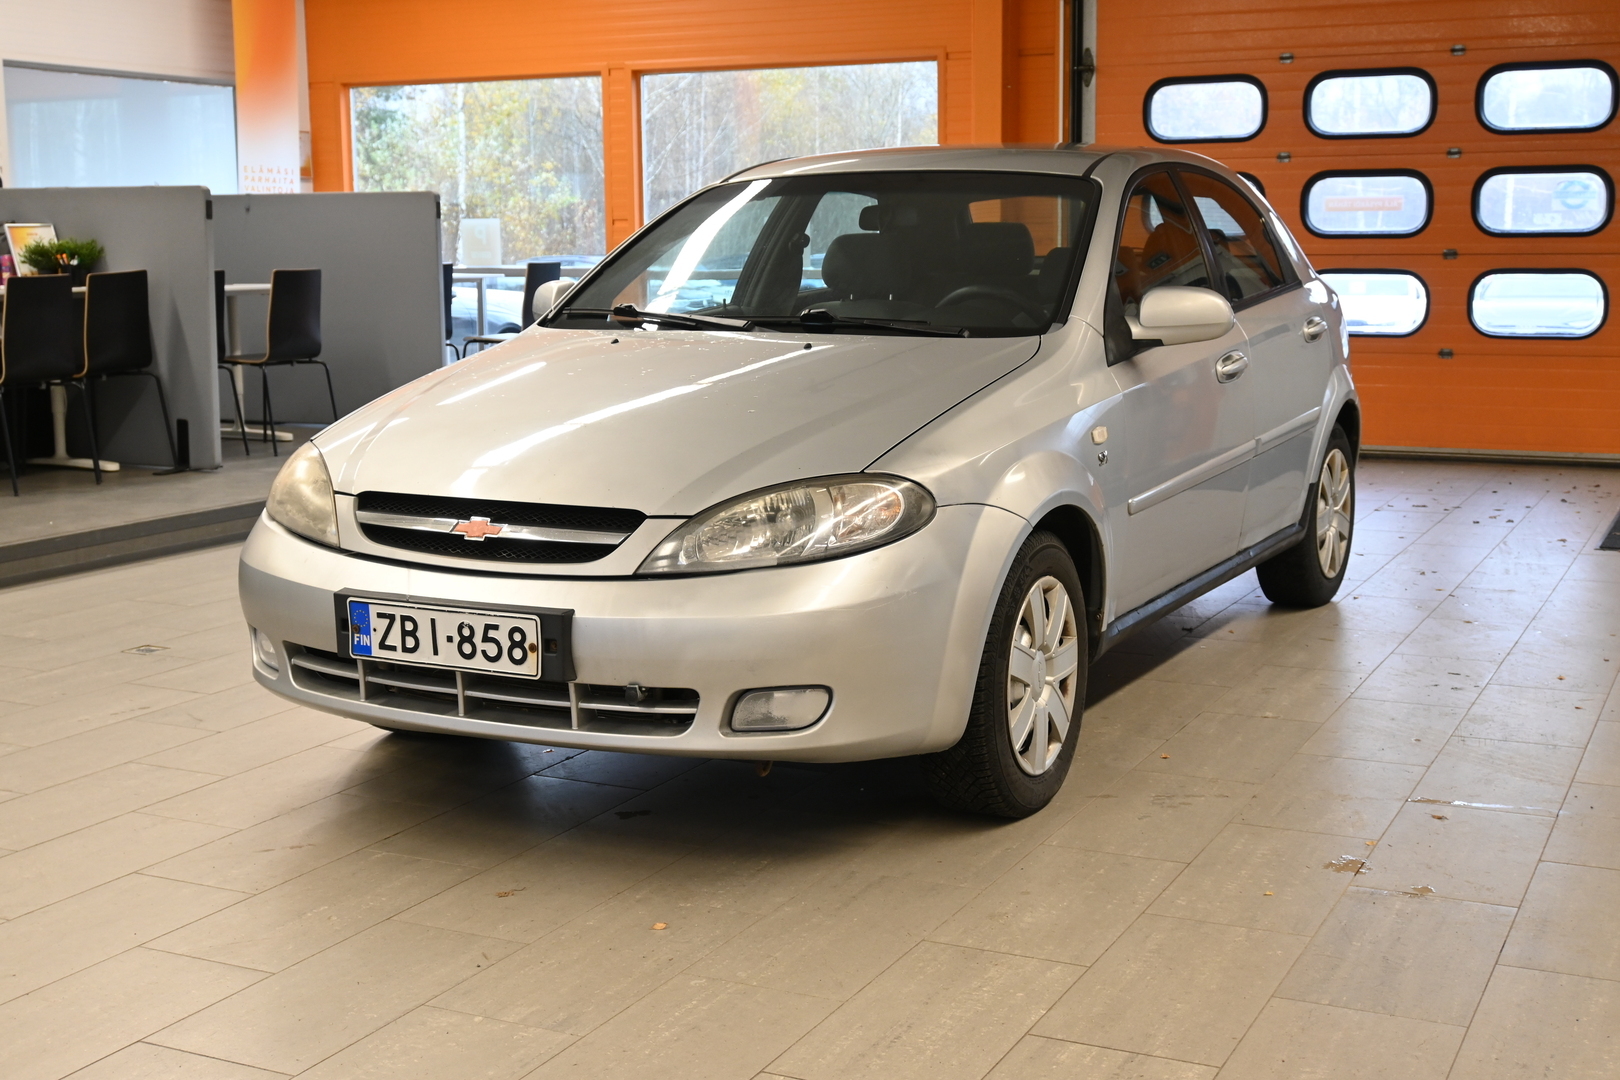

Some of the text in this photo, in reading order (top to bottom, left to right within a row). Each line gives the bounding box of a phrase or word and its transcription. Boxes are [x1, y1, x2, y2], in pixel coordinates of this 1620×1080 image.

[243, 165, 294, 176] ELÄMÄSI
[244, 175, 294, 185] PARHAITA
[244, 185, 294, 194] VALINTOJA
[354, 633, 371, 647] FIN
[376, 612, 528, 666] ZBI-858
